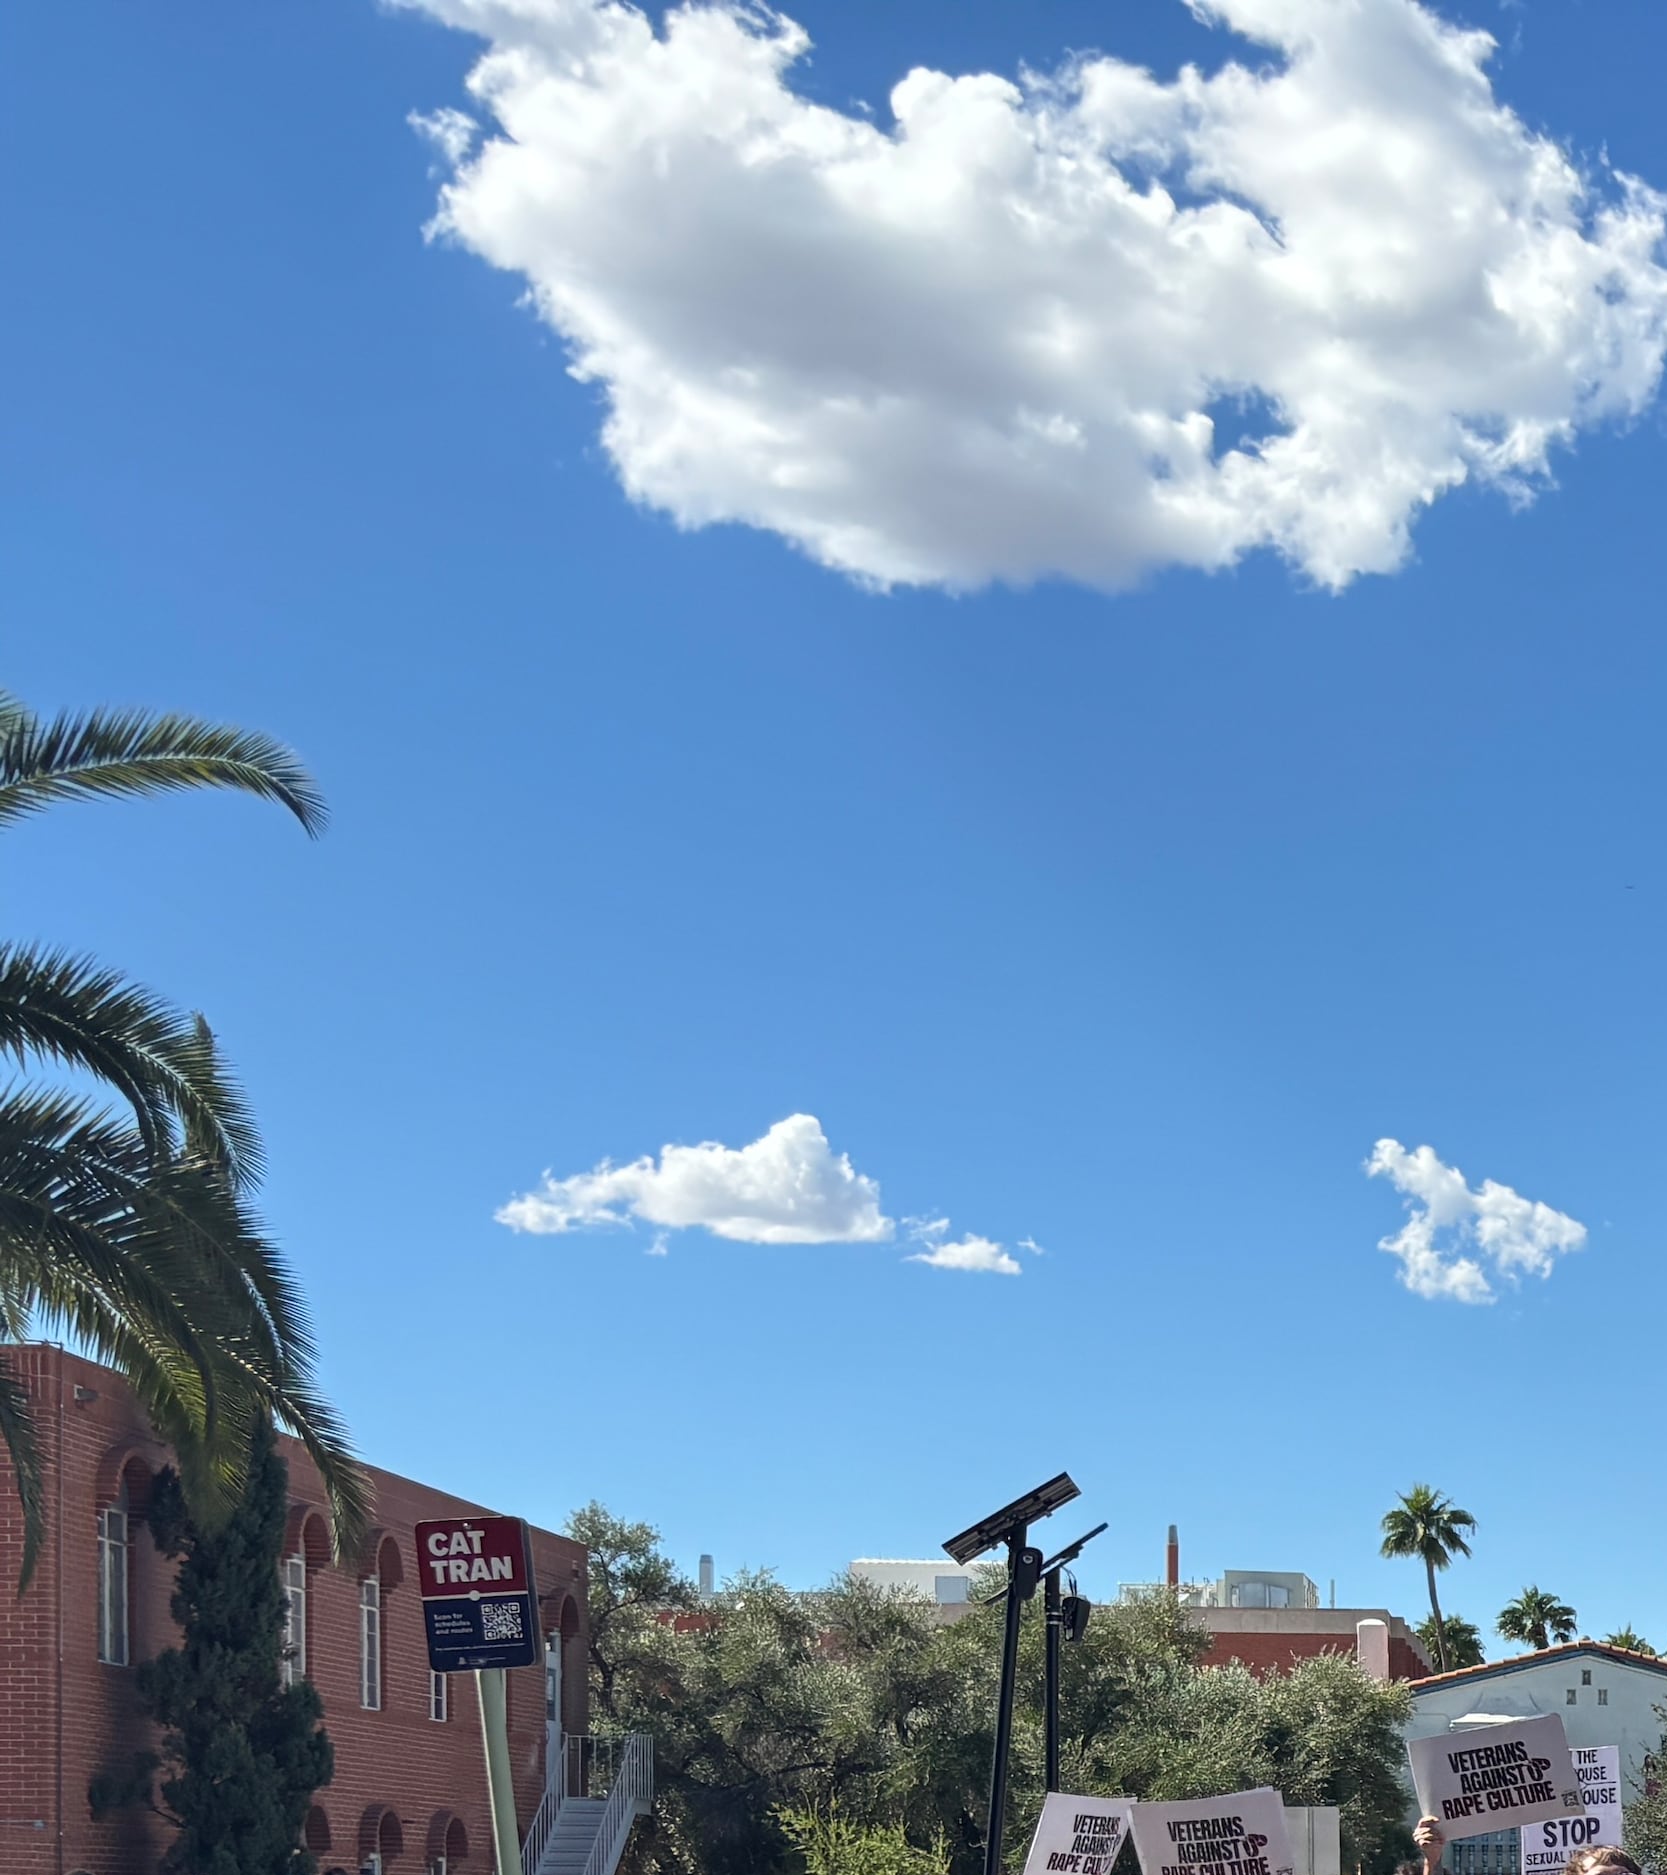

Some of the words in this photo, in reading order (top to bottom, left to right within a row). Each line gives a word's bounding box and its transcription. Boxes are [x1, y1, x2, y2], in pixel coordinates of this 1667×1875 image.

[428, 1531, 485, 1557] CAT
[430, 1556, 513, 1584] TRAN
[1448, 1741, 1529, 1773] VETERANS
[1577, 1750, 1598, 1764] THE
[1460, 1763, 1527, 1795] AGAINST
[1441, 1794, 1486, 1820] RAPE
[1486, 1781, 1556, 1811] CULTURE
[1073, 1814, 1121, 1835] VETERANS
[1167, 1816, 1245, 1842] VETERANS
[1543, 1817, 1600, 1848] STOP
[1046, 1852, 1081, 1873] RAPE
[1177, 1840, 1242, 1864] AGAINST
[1526, 1851, 1566, 1865] SEXUAL
